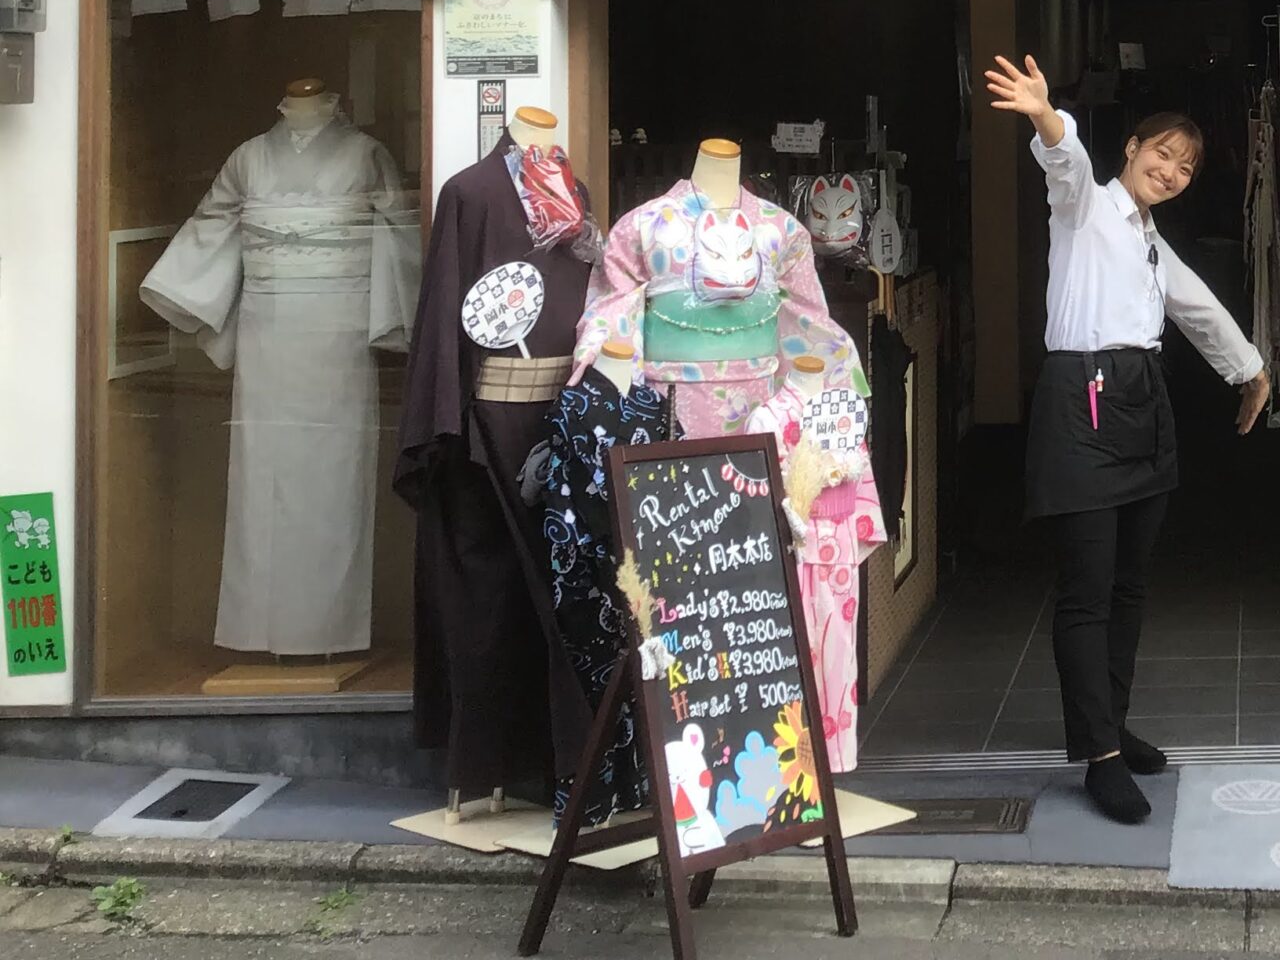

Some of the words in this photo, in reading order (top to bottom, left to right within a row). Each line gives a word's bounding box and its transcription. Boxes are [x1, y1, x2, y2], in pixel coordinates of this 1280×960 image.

[639, 467, 719, 532] Rental
[667, 492, 742, 557] Kimono
[8, 561, 53, 585] こども
[8, 593, 57, 630] 110番
[13, 638, 59, 664] のいえ
